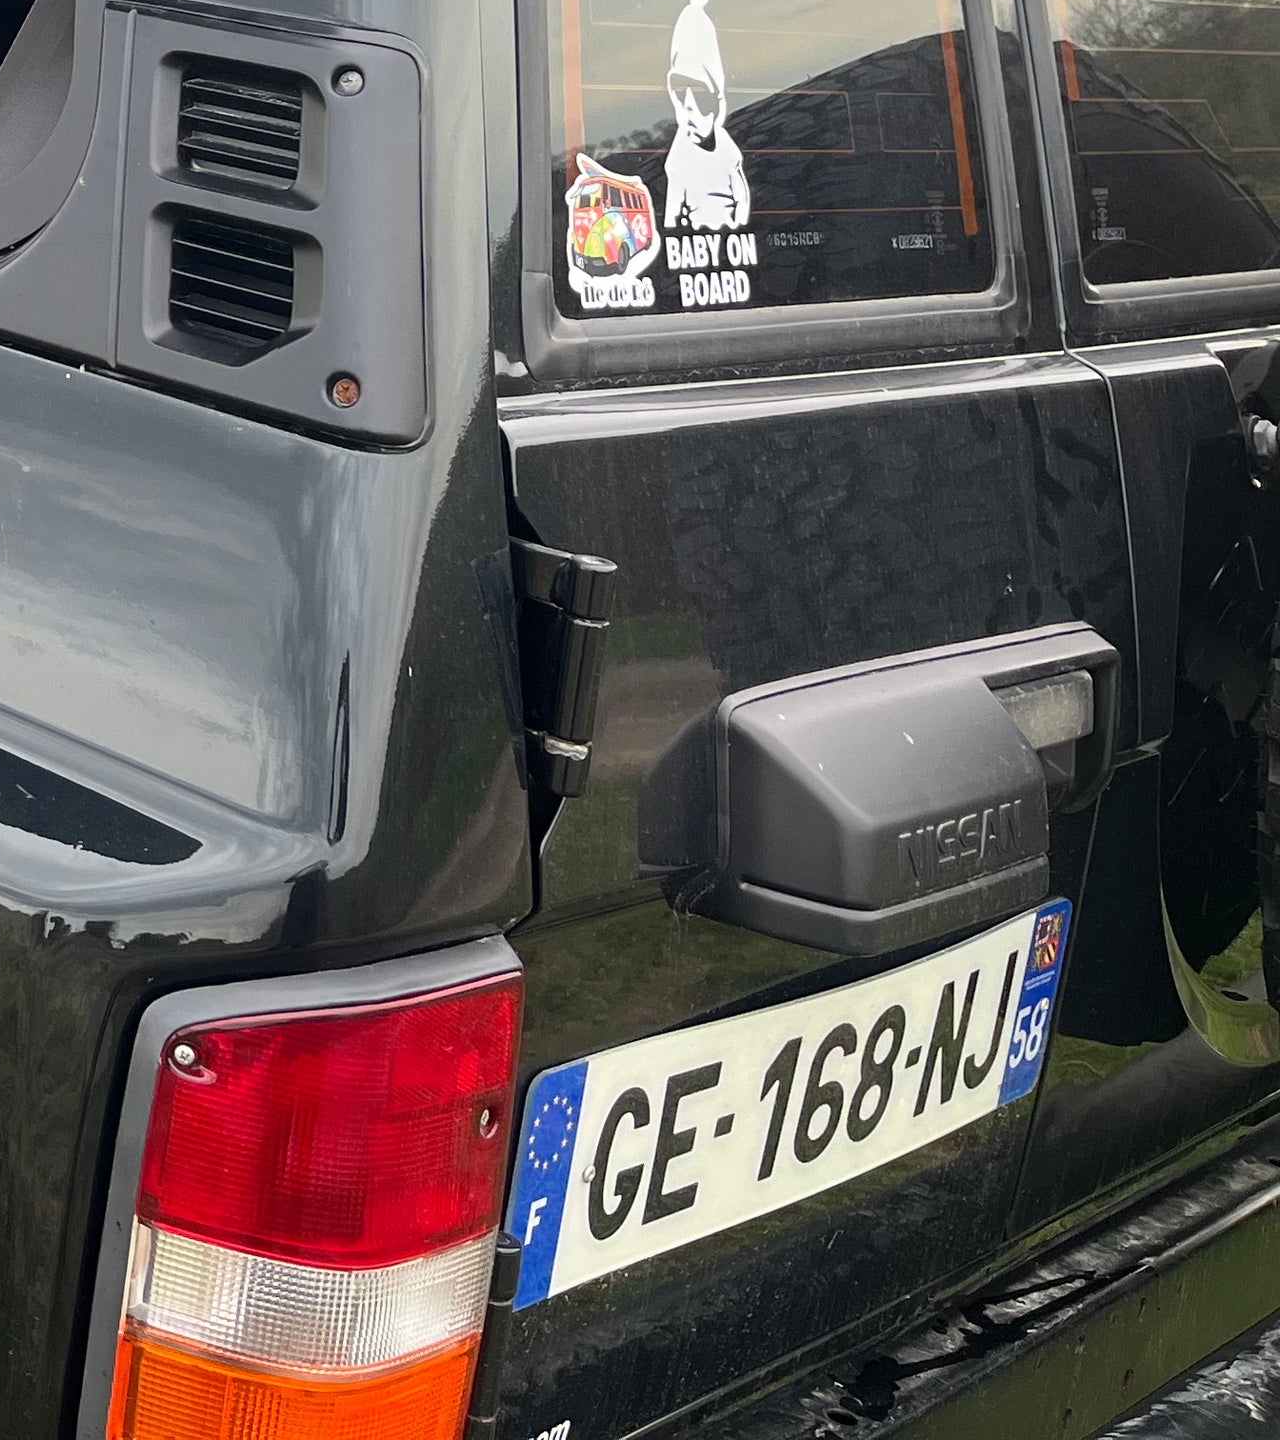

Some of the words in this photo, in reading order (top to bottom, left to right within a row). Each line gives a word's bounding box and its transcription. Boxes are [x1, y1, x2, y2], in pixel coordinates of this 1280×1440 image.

[665, 234, 721, 270] BABY
[726, 233, 758, 267] ON
[608, 284, 628, 302] de
[679, 270, 751, 307] BOARD
[897, 799, 1024, 888] NISSAN
[523, 1197, 548, 1246] F
[588, 950, 1019, 1241] GE-168-NJ
[1008, 997, 1050, 1069] 58
